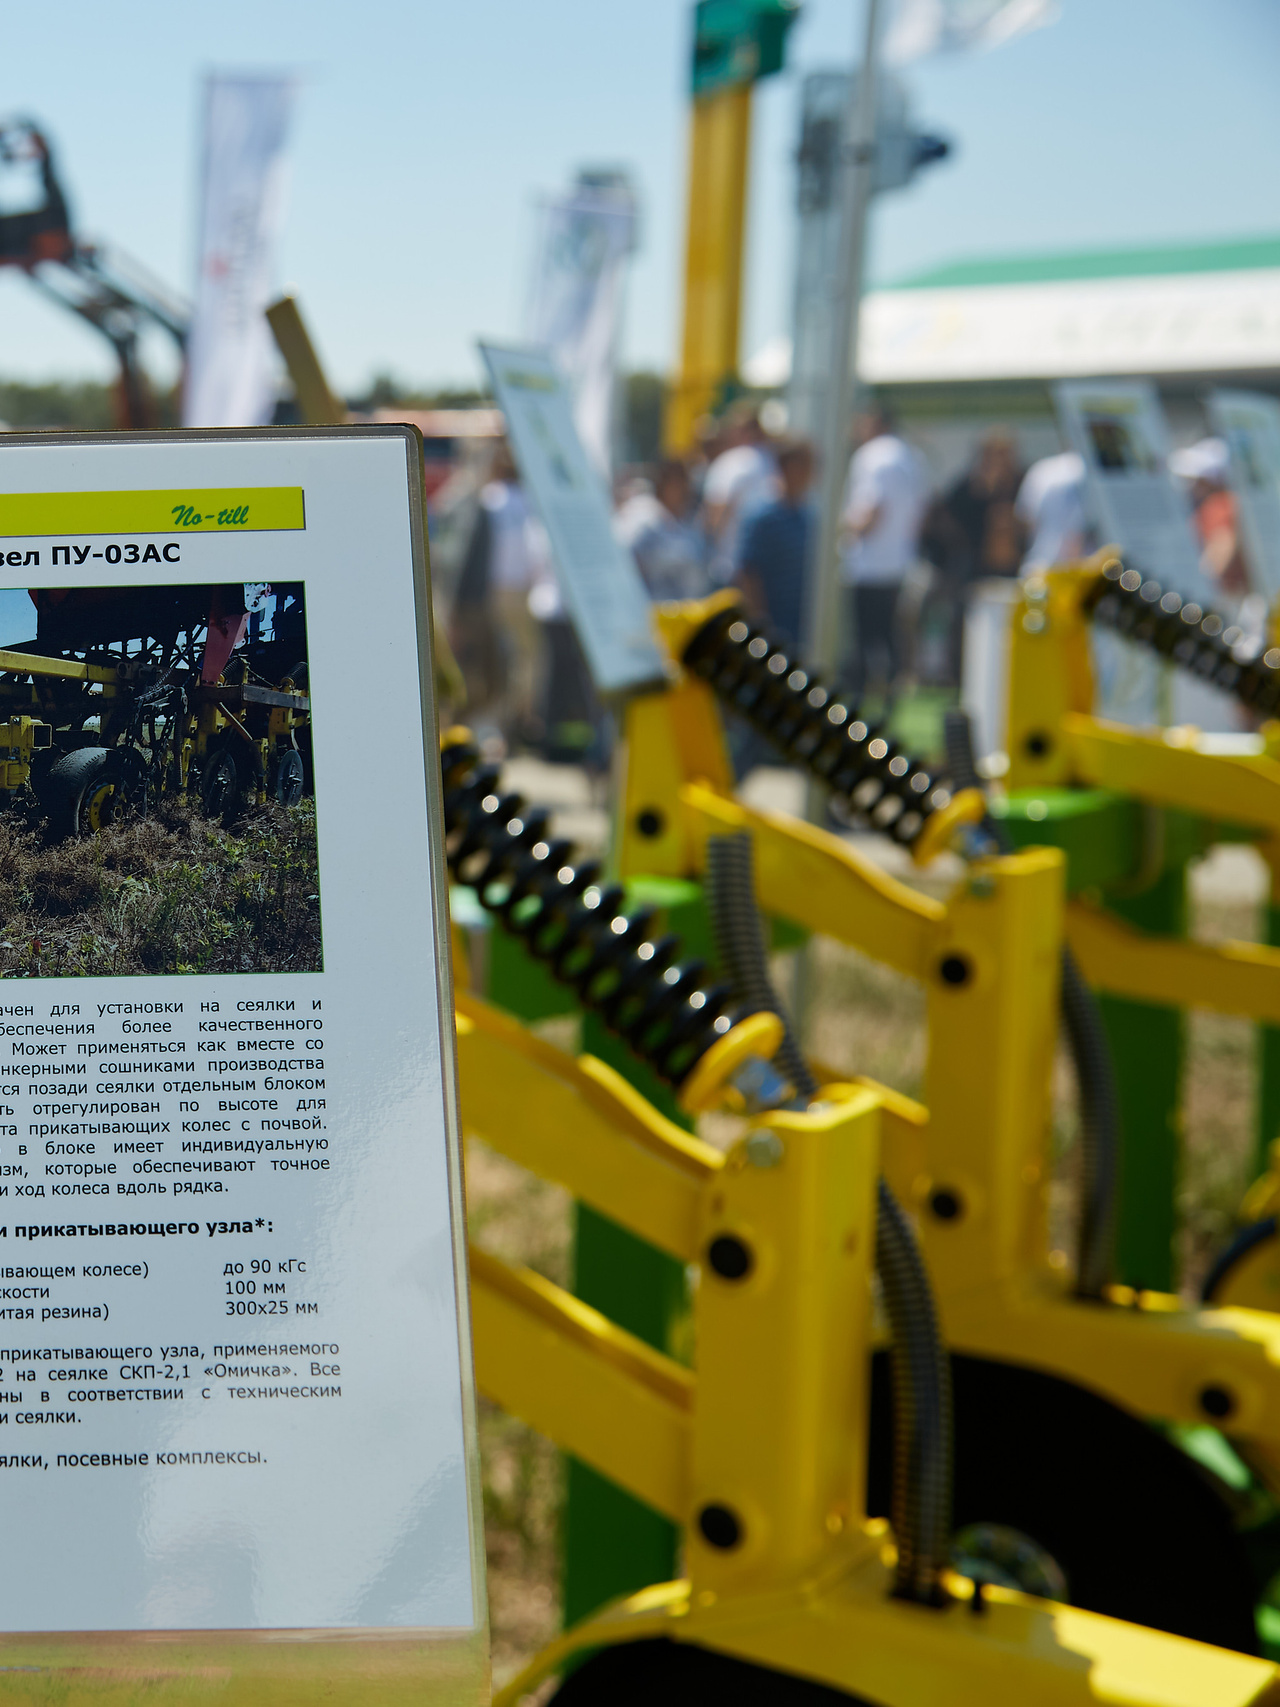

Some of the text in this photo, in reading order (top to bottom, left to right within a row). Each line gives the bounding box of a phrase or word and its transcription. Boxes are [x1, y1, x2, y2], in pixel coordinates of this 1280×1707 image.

[170, 504, 250, 527] No-till
[51, 542, 181, 566] ПУ-03АС
[49, 1004, 81, 1018] для
[96, 1002, 184, 1018] установки
[200, 1001, 220, 1013] на
[236, 1000, 296, 1012] сеялки
[311, 999, 322, 1011] и
[121, 1019, 172, 1034] более
[198, 1018, 323, 1033] качественного
[11, 1041, 68, 1056] Может
[77, 1041, 186, 1058] применяться
[196, 1040, 227, 1053] как
[236, 1039, 295, 1052] вместе
[305, 1038, 324, 1051] со
[98, 1061, 196, 1074] сошниками
[207, 1058, 325, 1075] производства
[28, 1083, 88, 1097] позади
[95, 1081, 155, 1094] сеялки
[162, 1079, 257, 1095] отдельным
[263, 1076, 326, 1091] блоком
[32, 1101, 161, 1119] отрегулирован
[179, 1100, 200, 1113] по
[218, 1099, 279, 1112] высоте
[295, 1098, 327, 1113] для
[28, 1121, 171, 1139] прикатывающих
[181, 1120, 232, 1133] колес
[240, 1119, 251, 1132] с
[260, 1115, 327, 1131] почвой.
[18, 1144, 28, 1156] в
[44, 1140, 96, 1156] блоке
[113, 1141, 165, 1154] имеет
[181, 1138, 329, 1155] индивидуальную
[44, 1162, 117, 1179] которые
[132, 1158, 257, 1174] обеспечивают
[269, 1158, 331, 1172] точное
[14, 1184, 46, 1199] ход
[51, 1183, 110, 1196] колеса
[116, 1182, 167, 1197] вдоль
[172, 1181, 229, 1197] рядка.
[14, 1222, 200, 1242] прикатывающего
[82, 1260, 149, 1280] колесе)
[222, 1262, 245, 1277] до
[250, 1258, 272, 1274] 90
[277, 1258, 307, 1274] кГс
[225, 1279, 257, 1295] 100
[263, 1282, 286, 1295] мм
[41, 1302, 110, 1323] резина)
[295, 1302, 319, 1315] мм
[0, 1346, 153, 1365] прикатывающего
[159, 1345, 205, 1362] узла,
[213, 1343, 340, 1360] применяемого
[16, 1369, 37, 1382] на
[47, 1368, 109, 1382] сеялке
[119, 1364, 191, 1382] СКП-2,1
[203, 1362, 298, 1378] «Омичка».
[310, 1361, 341, 1377] Все
[40, 1390, 51, 1403] в
[67, 1388, 184, 1403] соответствии
[201, 1387, 211, 1400] с
[227, 1386, 342, 1399] техническим
[15, 1411, 82, 1425] сеялки.
[56, 1452, 149, 1467] посевные
[156, 1451, 268, 1465] комплексы.
